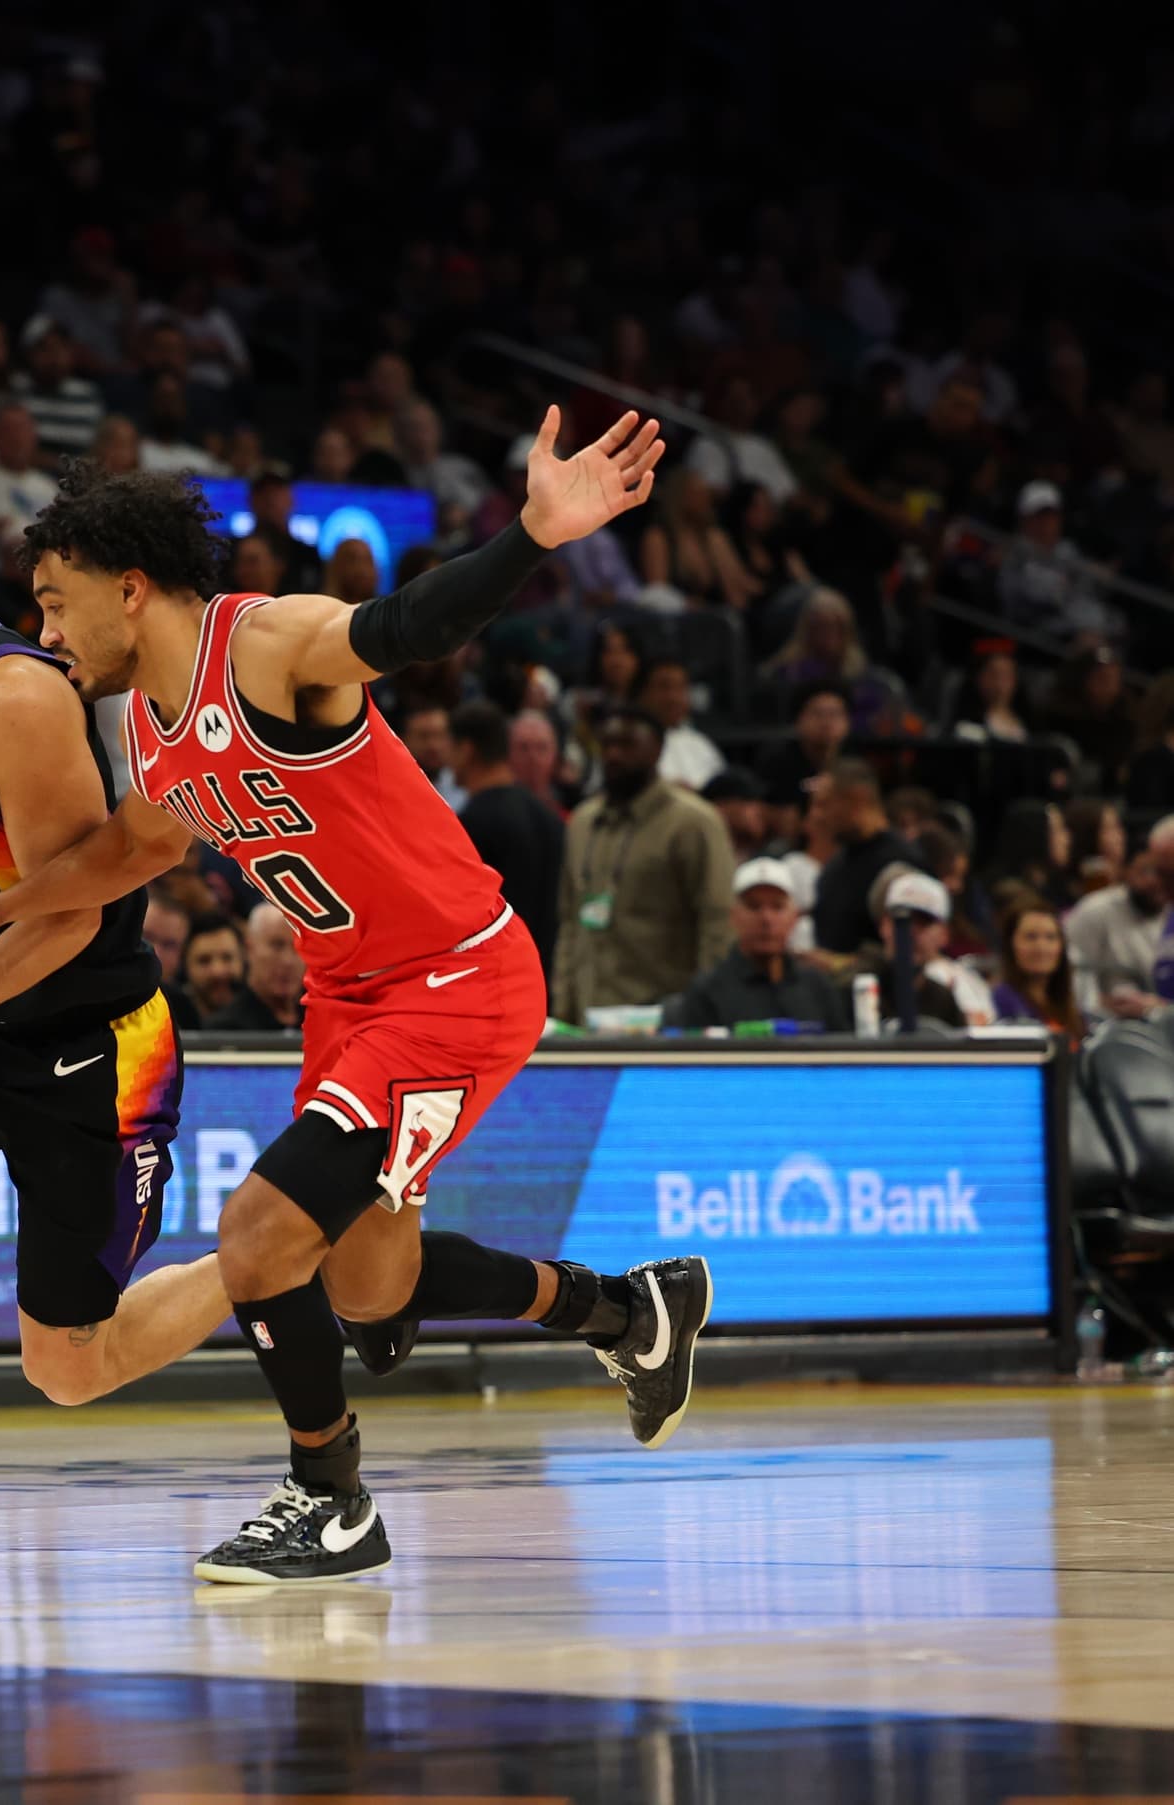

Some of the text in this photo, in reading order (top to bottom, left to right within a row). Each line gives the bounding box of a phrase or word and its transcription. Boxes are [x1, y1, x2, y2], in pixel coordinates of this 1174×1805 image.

[158, 768, 317, 851] ULLS
[242, 850, 356, 938] 0
[656, 1167, 981, 1238] Bell Bank
